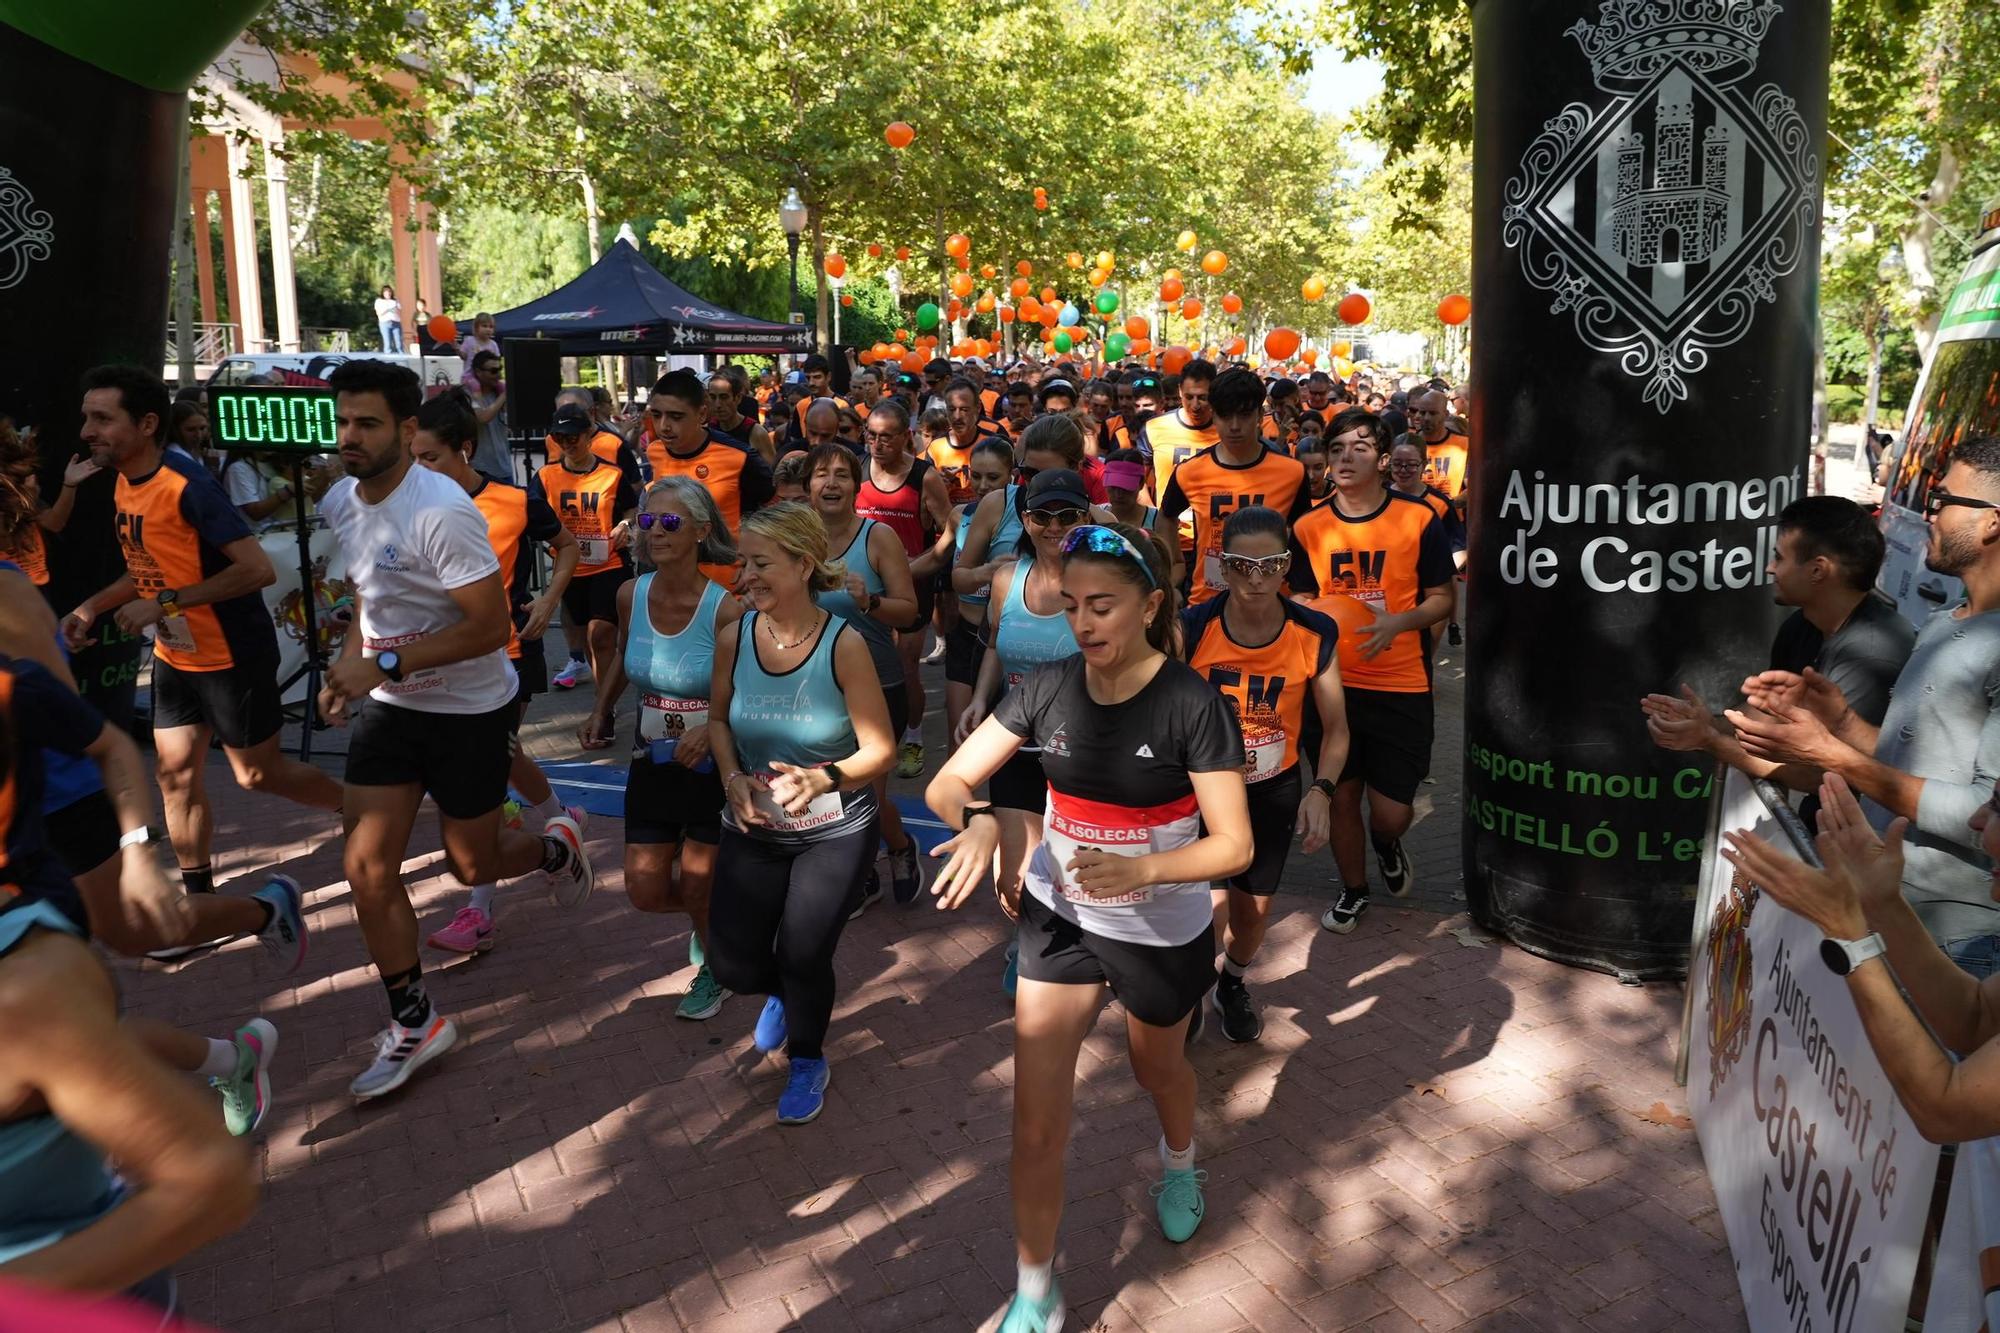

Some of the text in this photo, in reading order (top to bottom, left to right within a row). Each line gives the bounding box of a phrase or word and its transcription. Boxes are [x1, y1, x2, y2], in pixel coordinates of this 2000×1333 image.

[1499, 464, 1801, 537] Ajuntament
[1500, 525, 1778, 593] de Castell
[659, 699, 710, 710] ASOLECAS
[664, 712, 685, 730] 93
[740, 712, 813, 722] RUNNING
[1243, 730, 1285, 746] OLECAS
[1243, 766, 1281, 782] tander
[1464, 743, 1554, 789] esport
[1566, 769, 1658, 800] mou
[775, 810, 841, 830] Santander
[783, 807, 813, 818] ELENA
[1068, 824, 1149, 841] ASOLECAS
[1466, 794, 1620, 859] ASTELLÓ
[1768, 938, 1897, 1222] Ajuntament de
